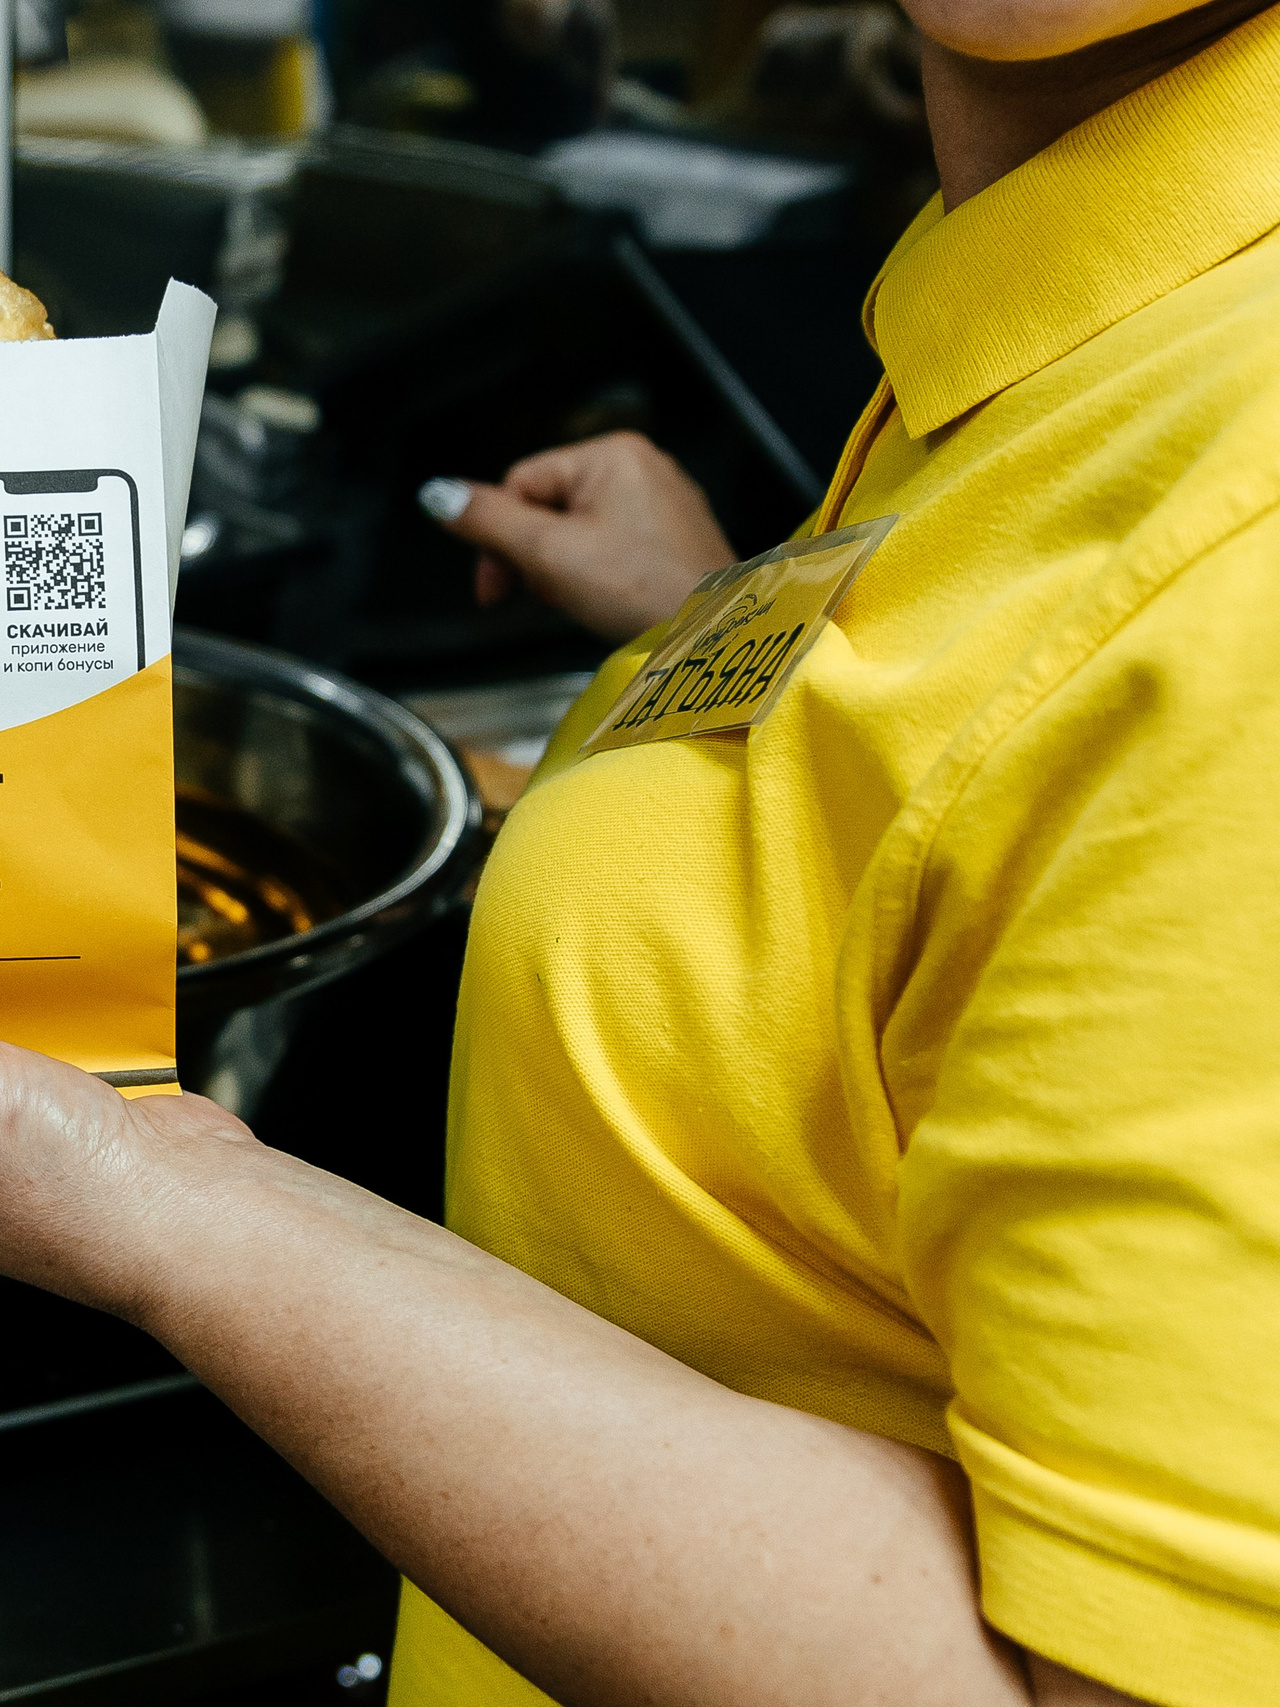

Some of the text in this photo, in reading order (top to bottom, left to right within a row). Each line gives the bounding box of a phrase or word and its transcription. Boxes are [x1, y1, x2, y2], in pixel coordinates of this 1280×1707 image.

[6, 618, 109, 639] СКАЧИВАЙ
[11, 641, 106, 657] приложение
[3, 658, 114, 673] и копи бонусы
[612, 622, 805, 731] ТАТЬЯНА
